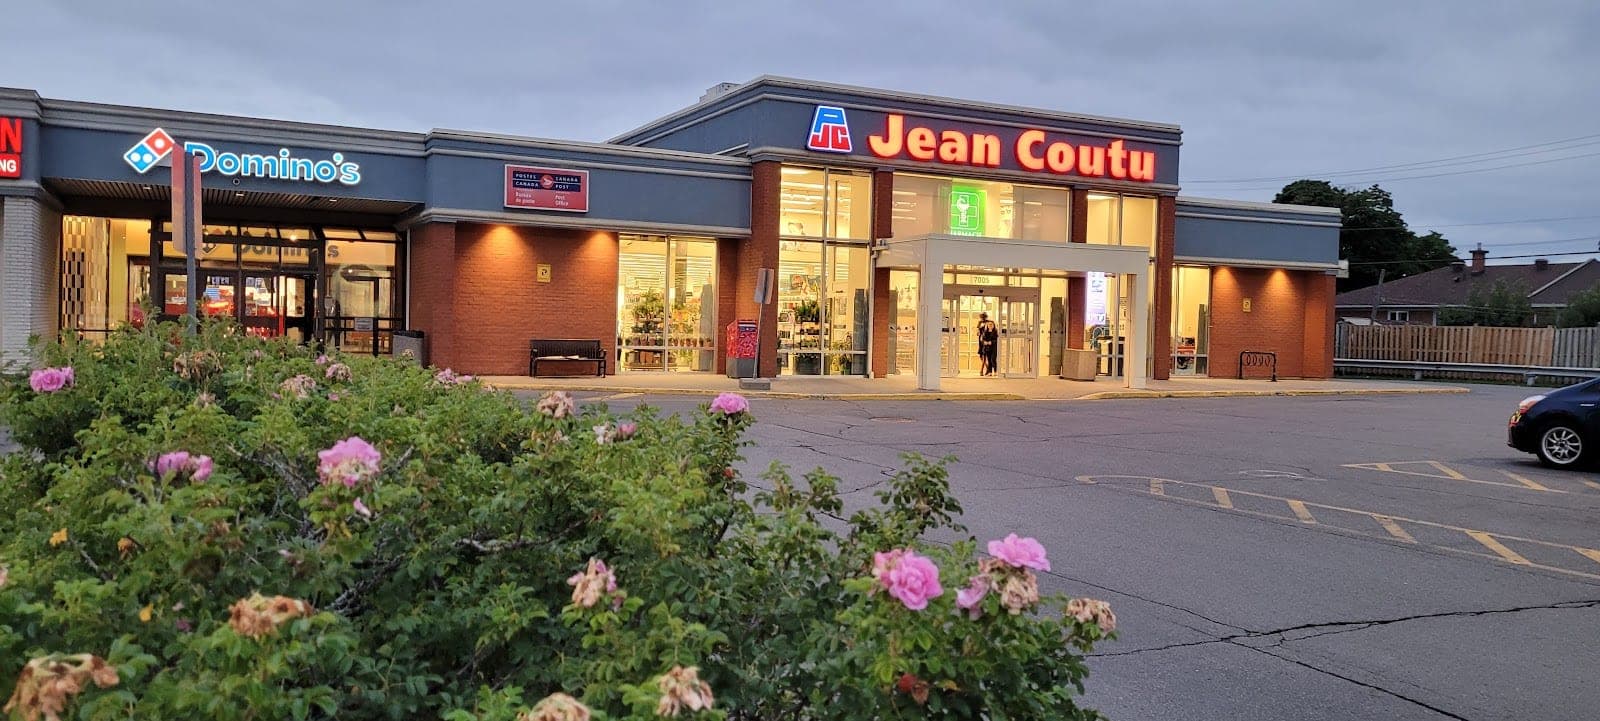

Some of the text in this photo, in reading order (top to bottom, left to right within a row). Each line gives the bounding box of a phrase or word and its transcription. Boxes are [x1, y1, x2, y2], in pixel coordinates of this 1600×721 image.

[184, 141, 361, 185] Domino's
[868, 113, 1156, 182] Jean Coutu
